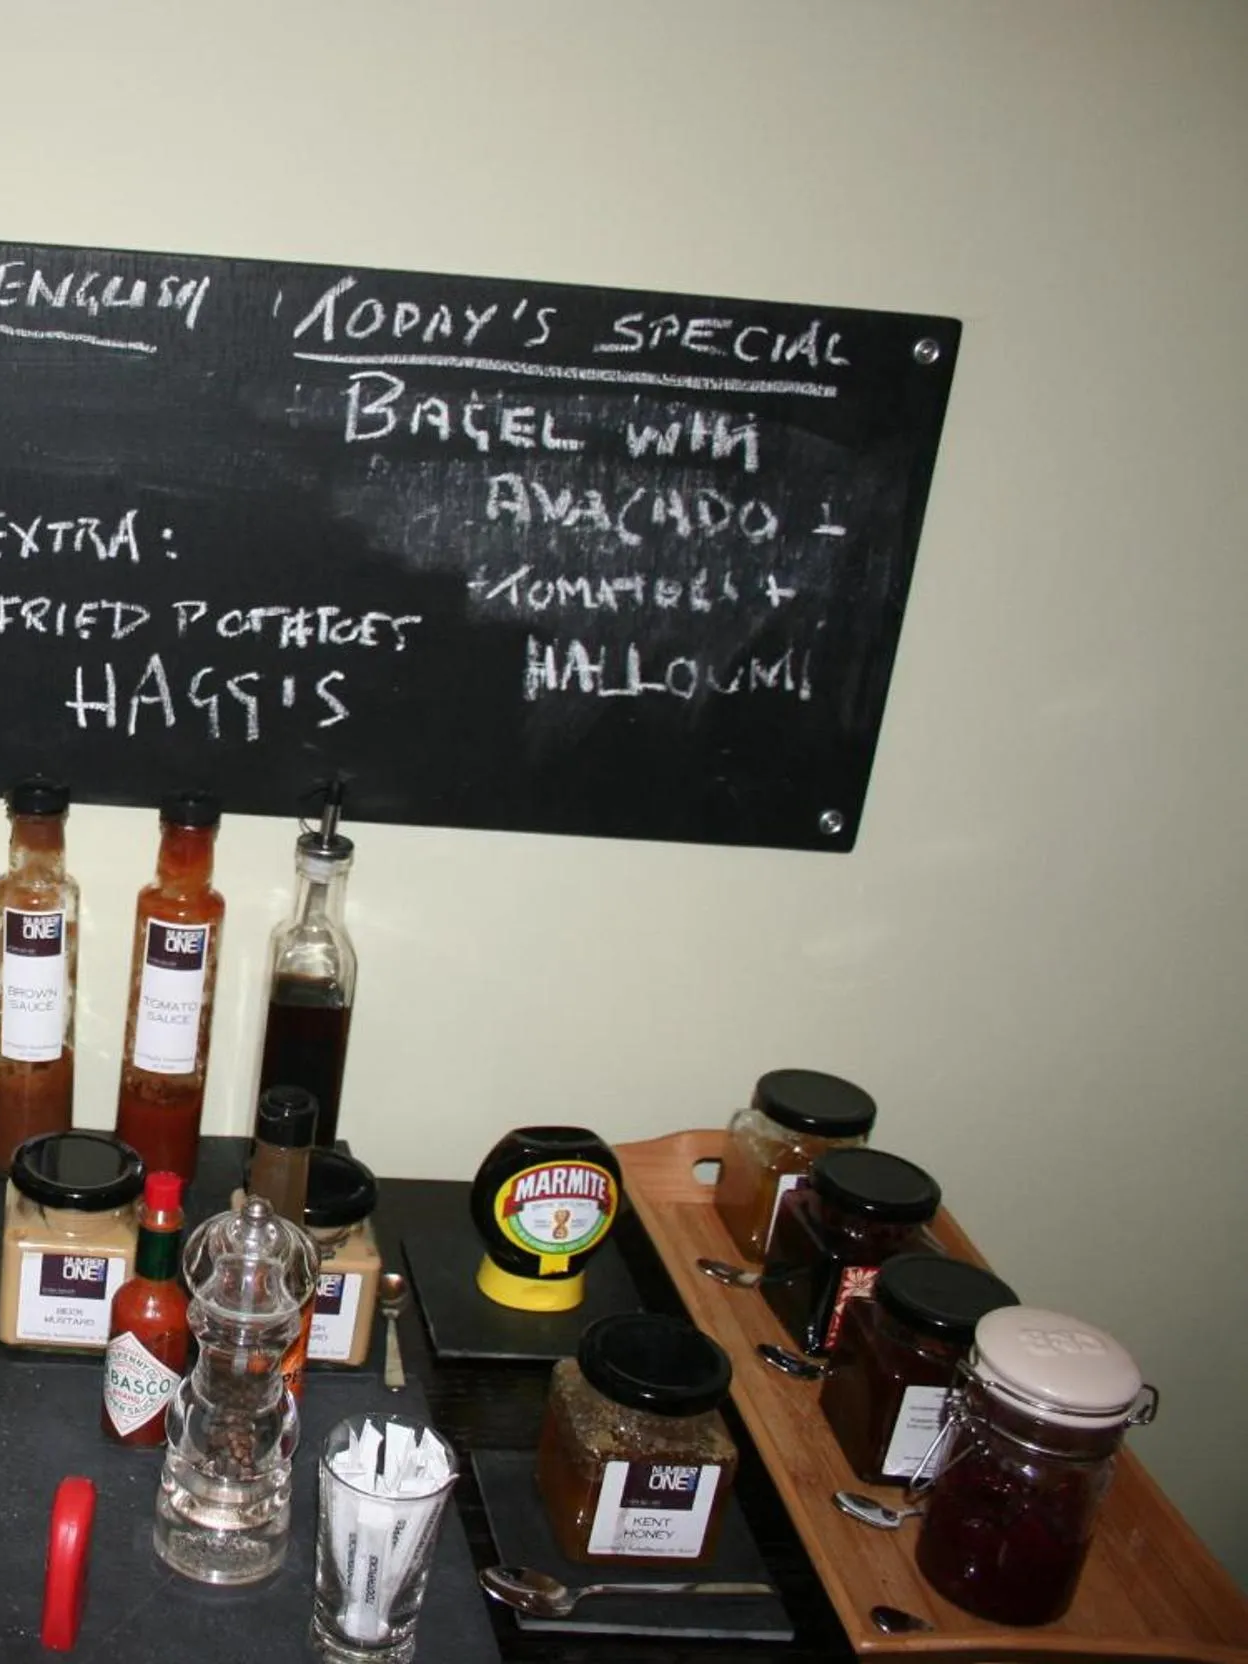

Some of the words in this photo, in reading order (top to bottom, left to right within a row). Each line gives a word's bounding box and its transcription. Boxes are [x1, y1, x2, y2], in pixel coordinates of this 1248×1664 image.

[593, 312, 851, 366] SPECIAL
[345, 370, 586, 451] BAGEL
[64, 652, 350, 741] HAGGIS
[22, 924, 57, 940] ONE
[164, 938, 199, 954] ONE
[7, 986, 58, 999] BROWN
[9, 1000, 55, 1012] SAUCE
[144, 996, 198, 1012] TOMATO
[146, 1010, 192, 1025] SAUCE
[515, 1167, 607, 1203] MARMITE
[62, 1264, 99, 1281] ONE
[107, 1368, 171, 1395] BASCO
[652, 1465, 698, 1476] NUMBER
[648, 1474, 688, 1491] ONE
[633, 1517, 672, 1527] KENT
[624, 1530, 676, 1540] HONEY
